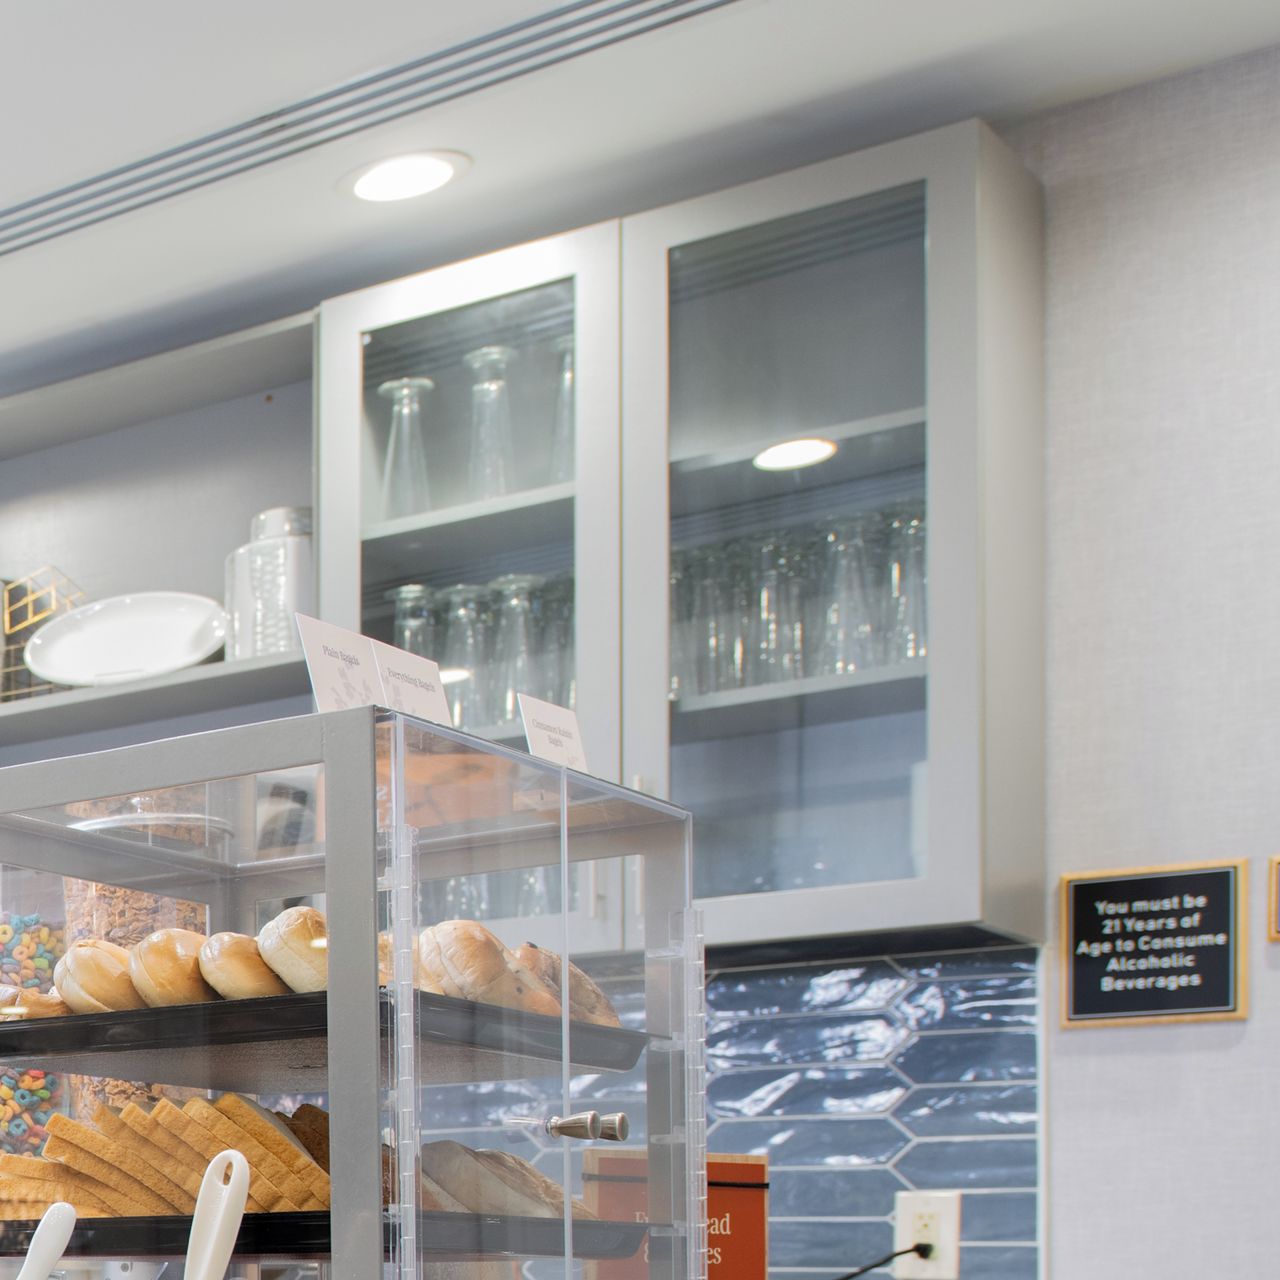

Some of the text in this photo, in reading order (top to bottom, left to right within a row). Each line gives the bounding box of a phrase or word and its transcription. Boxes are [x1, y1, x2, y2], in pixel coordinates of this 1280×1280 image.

[1094, 894, 1208, 916] You must be
[1101, 912, 1201, 935] 21 Years of
[1075, 933, 1228, 957] Age to Consume
[1105, 952, 1196, 972] Alcoholic
[1100, 973, 1202, 992] Beverages
